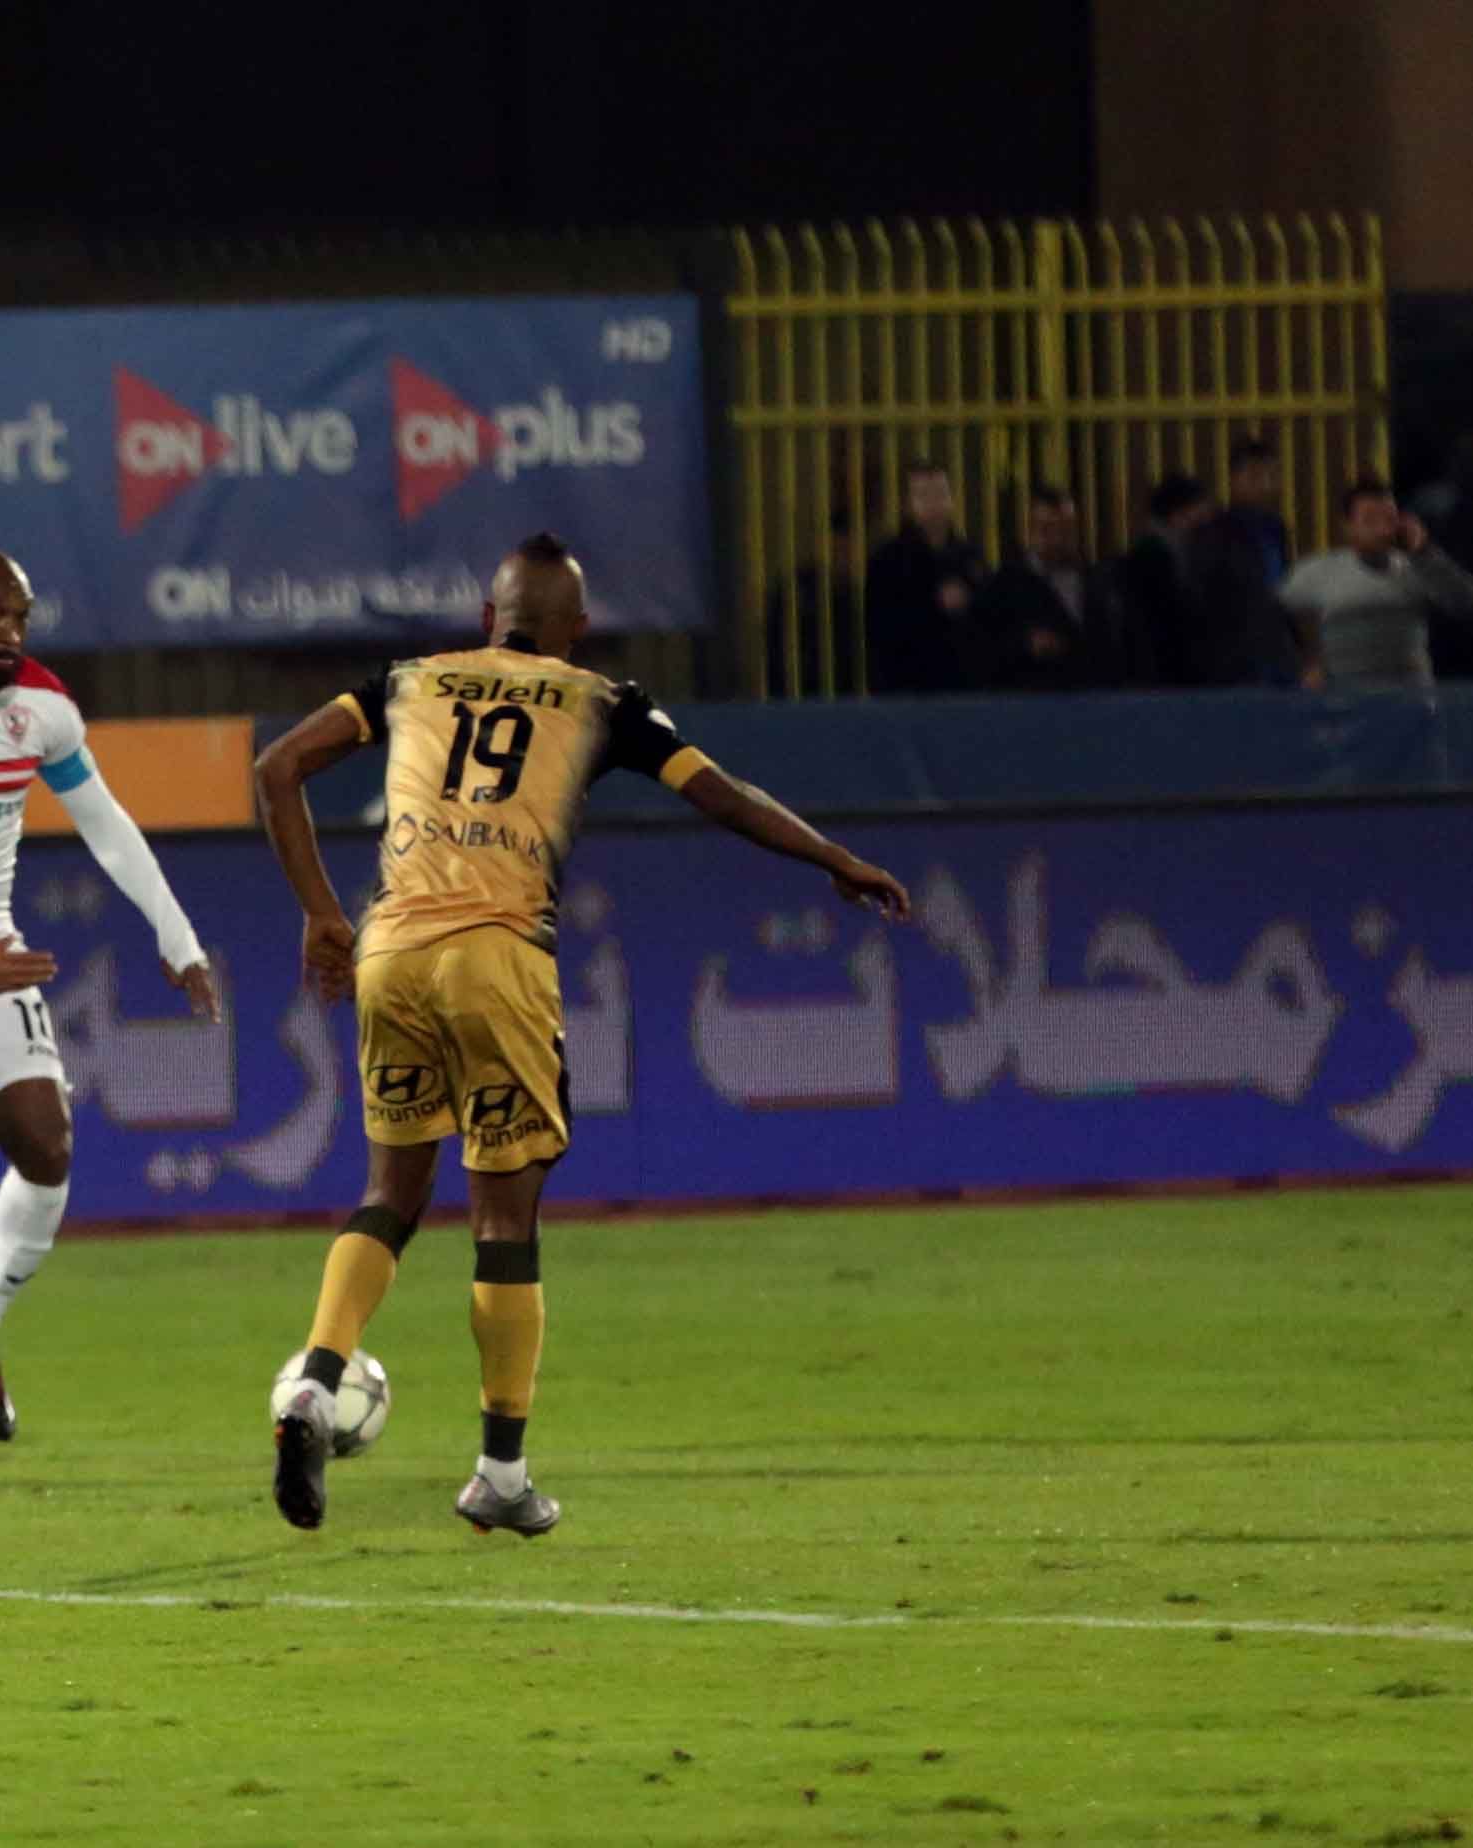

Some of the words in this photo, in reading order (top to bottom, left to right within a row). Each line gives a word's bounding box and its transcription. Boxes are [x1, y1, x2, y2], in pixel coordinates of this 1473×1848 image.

[119, 421, 205, 477] ON
[213, 394, 359, 477] live
[399, 411, 478, 465] ON
[494, 386, 646, 484] plus
[146, 566, 231, 620] ON
[435, 672, 564, 709] Saleh
[439, 701, 534, 803] 19
